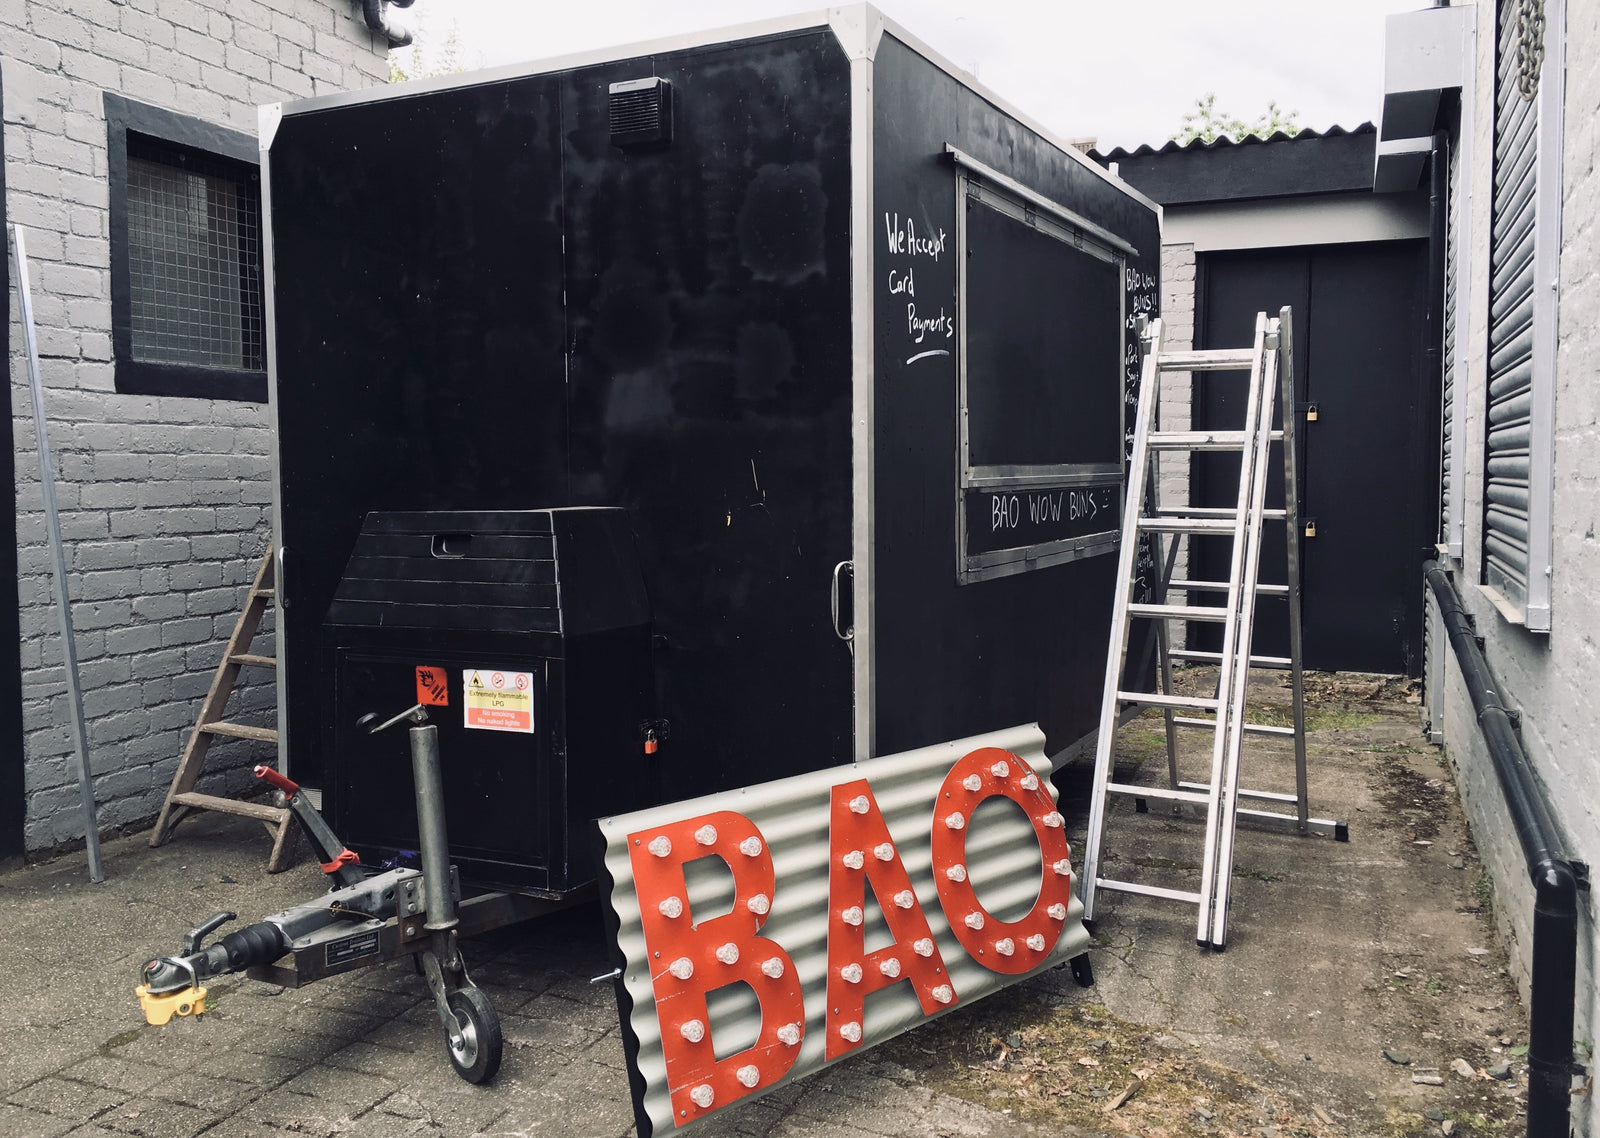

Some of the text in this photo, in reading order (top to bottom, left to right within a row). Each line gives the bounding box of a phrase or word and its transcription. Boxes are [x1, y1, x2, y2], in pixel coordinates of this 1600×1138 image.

[885, 212, 946, 262] We Accept
[888, 267, 915, 297] Card
[907, 302, 953, 343] Payments
[992, 490, 1097, 532] BAO WOW BUNS
[469, 689, 529, 700] Extremely flammable
[491, 710, 515, 719] smoking
[627, 747, 1071, 1128] BAO
